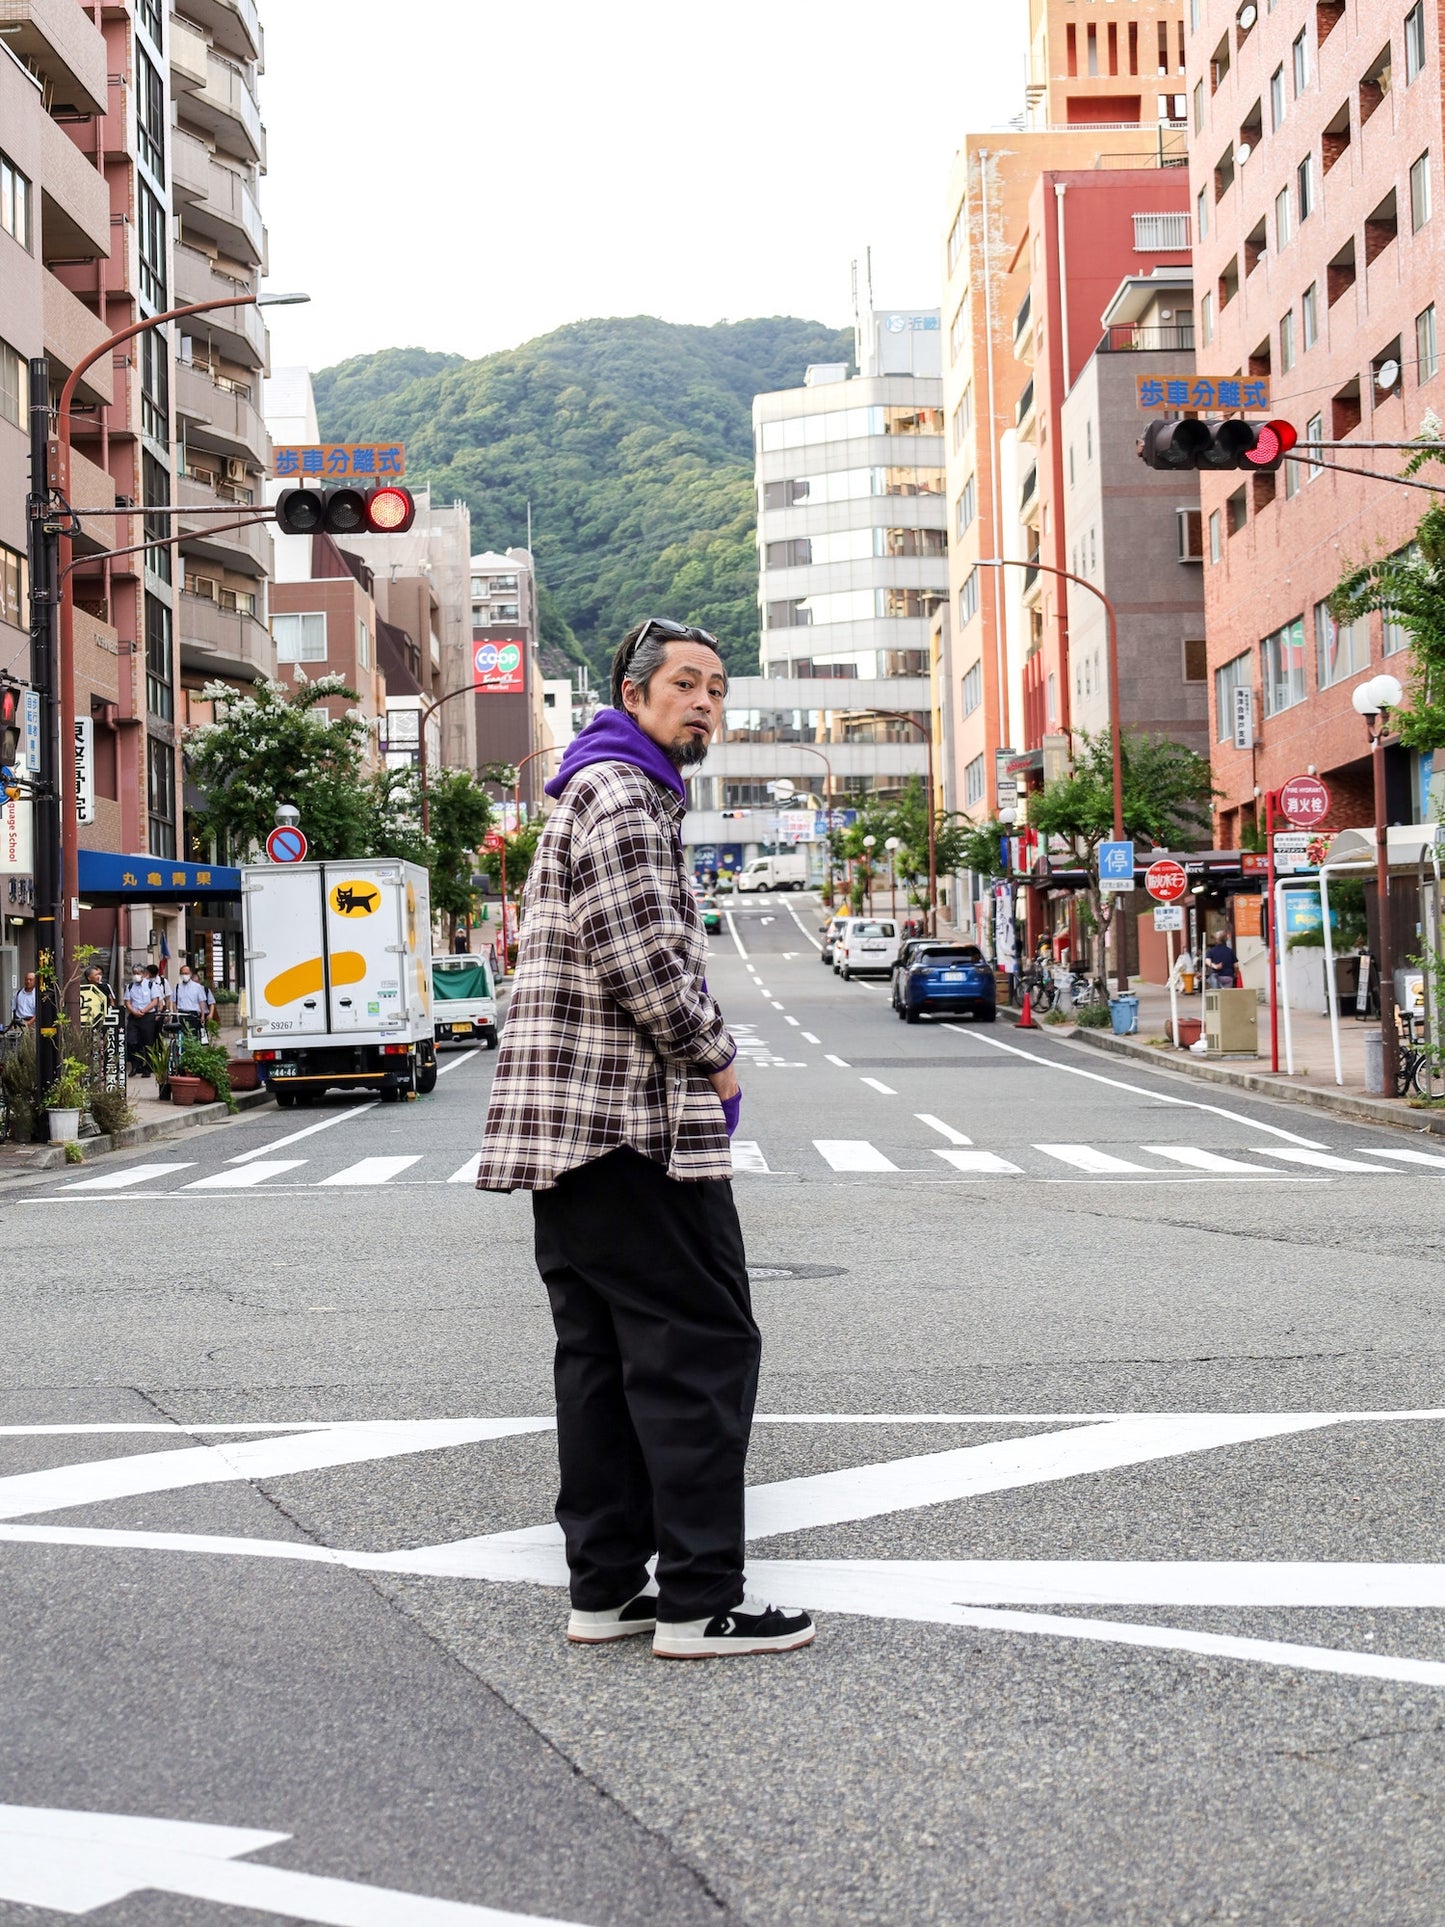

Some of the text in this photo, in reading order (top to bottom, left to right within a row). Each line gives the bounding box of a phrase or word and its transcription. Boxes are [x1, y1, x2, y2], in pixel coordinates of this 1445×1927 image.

[1140, 379, 1267, 408] 歩車分離式
[276, 447, 401, 475] 歩車分離式
[1287, 797, 1322, 812] 消火栓
[7, 802, 17, 862] guage School
[1104, 848, 1128, 873] 停
[271, 1021, 293, 1030] S9267
